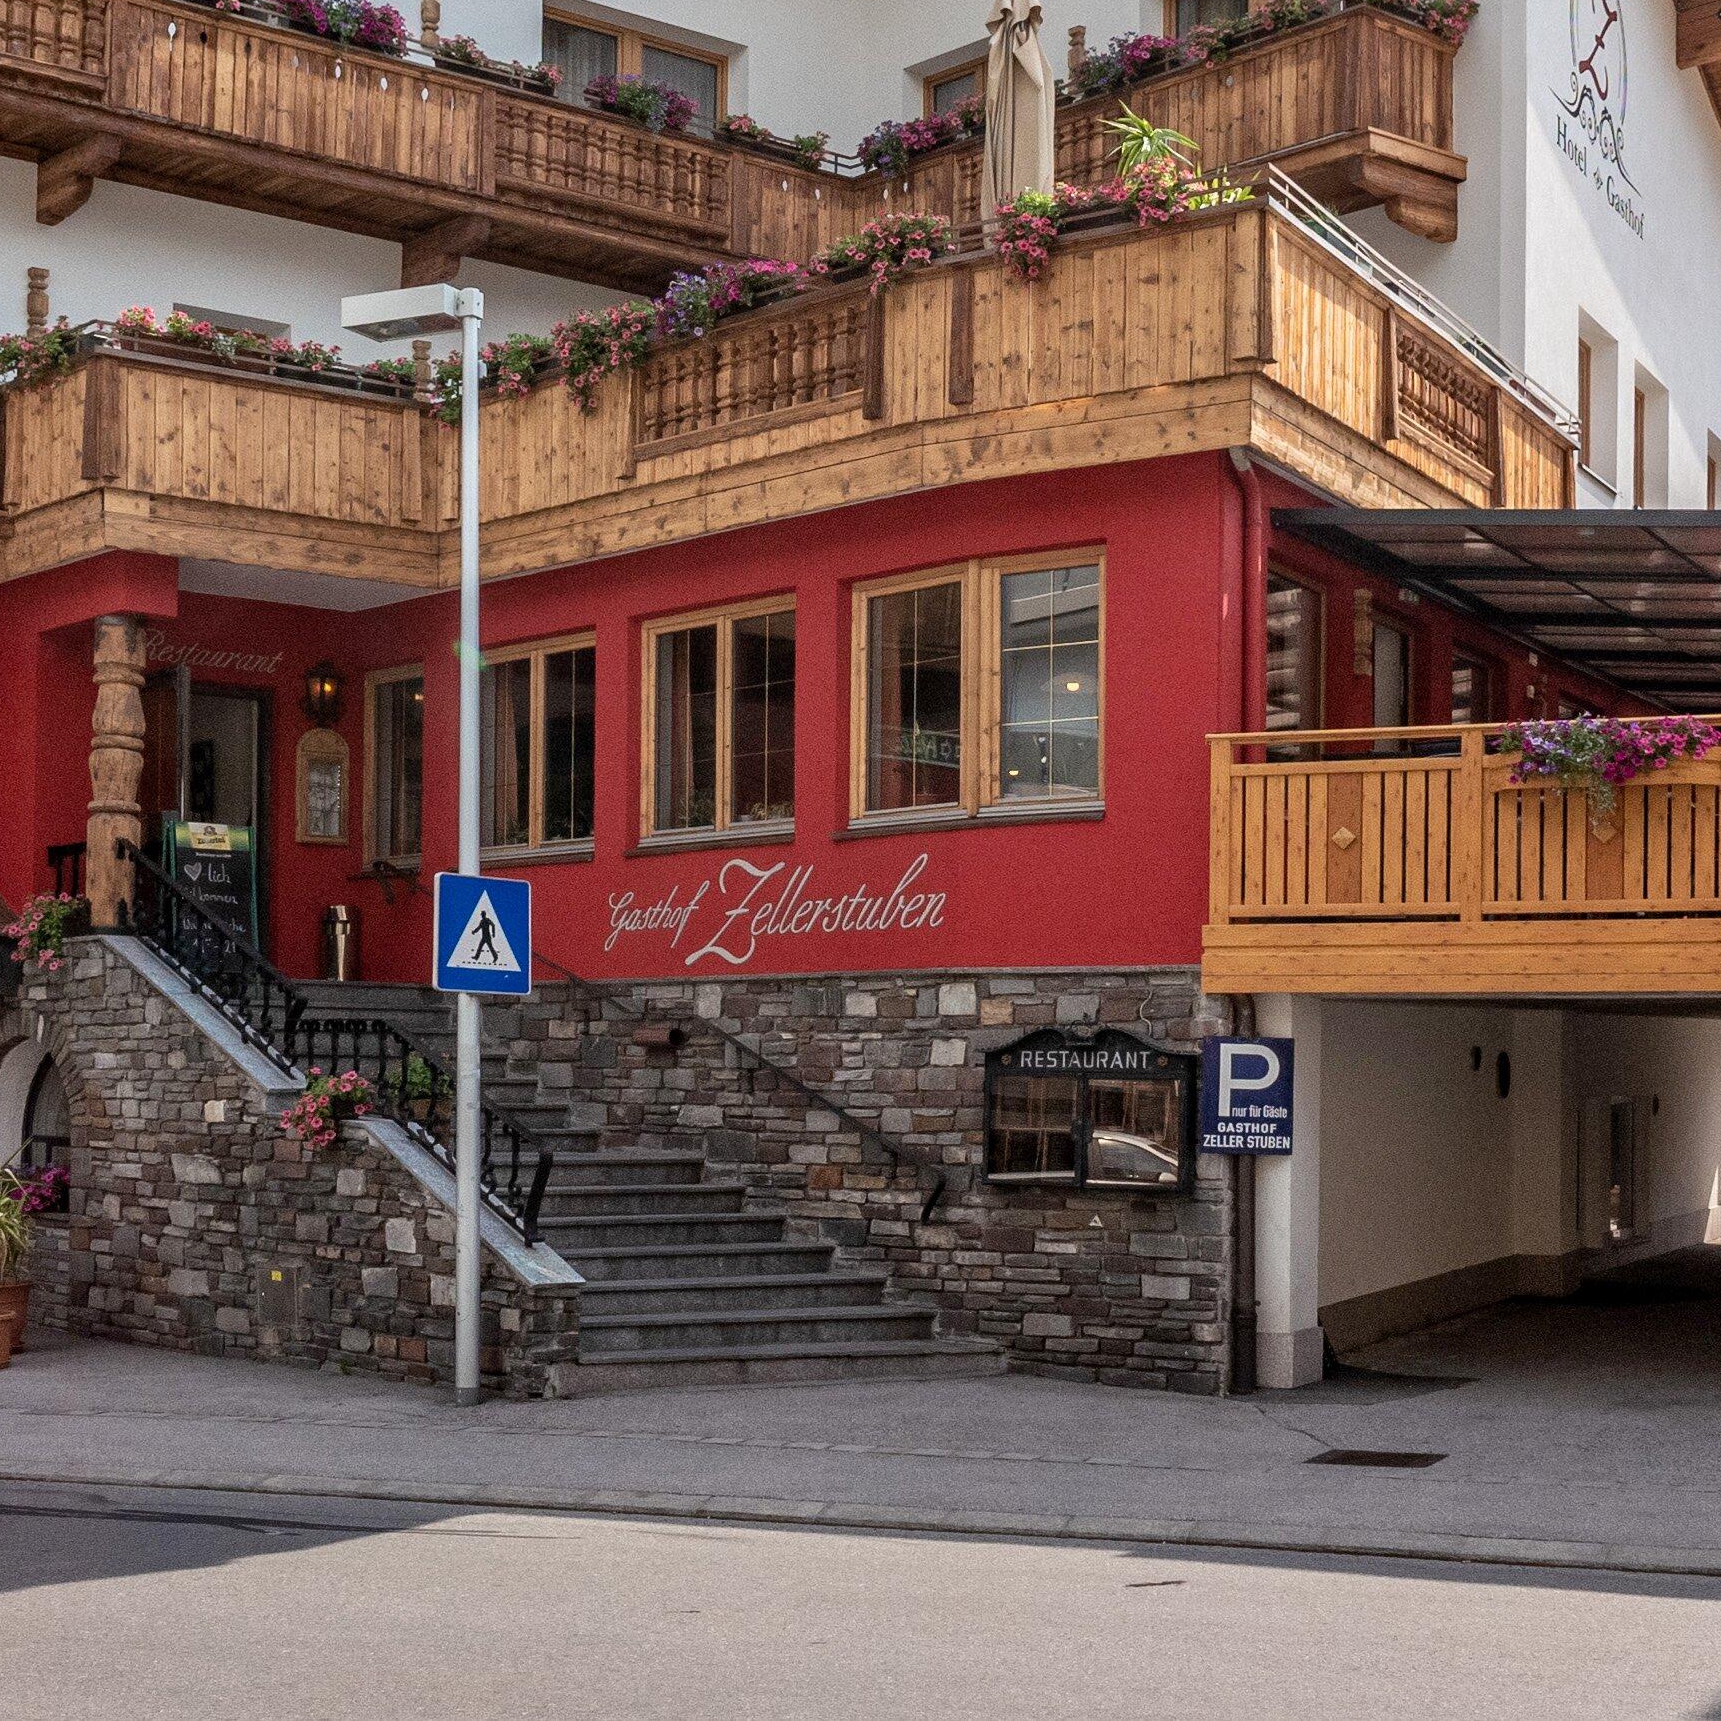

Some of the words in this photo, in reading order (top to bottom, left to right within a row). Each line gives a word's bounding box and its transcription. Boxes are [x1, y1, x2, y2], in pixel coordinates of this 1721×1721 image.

[1556, 114, 1588, 178] Hotel
[1606, 175, 1645, 240] Gasthof
[146, 629, 284, 675] Restaurant
[604, 880, 710, 952] Gasthof
[684, 853, 947, 966] Zellerstuben
[1020, 1050, 1150, 1069] RESTAURANT
[1218, 1042, 1280, 1117] P
[1231, 1107, 1247, 1117] nur
[1249, 1105, 1262, 1117] für
[1263, 1104, 1288, 1118] Gäste
[1203, 1134, 1244, 1148] ZELLER
[1247, 1135, 1291, 1149] STUBEN
[1217, 1122, 1277, 1134] GASTHOF
